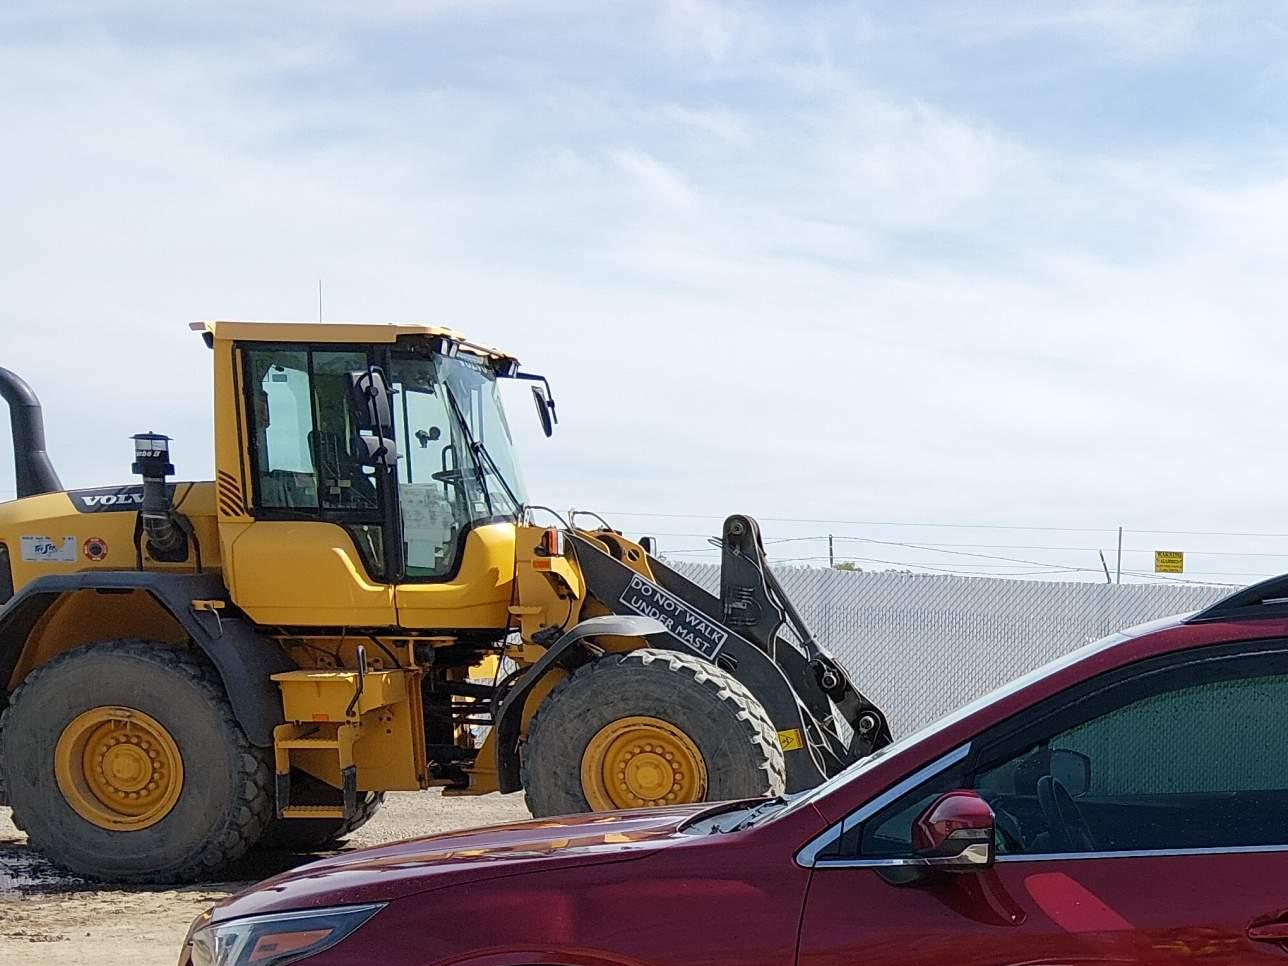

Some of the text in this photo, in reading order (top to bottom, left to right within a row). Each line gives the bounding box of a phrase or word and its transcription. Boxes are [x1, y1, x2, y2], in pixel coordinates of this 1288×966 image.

[81, 493, 145, 506] VOLV
[631, 578, 722, 644] DO NOT WALK
[631, 595, 711, 652] UNDER MAST
